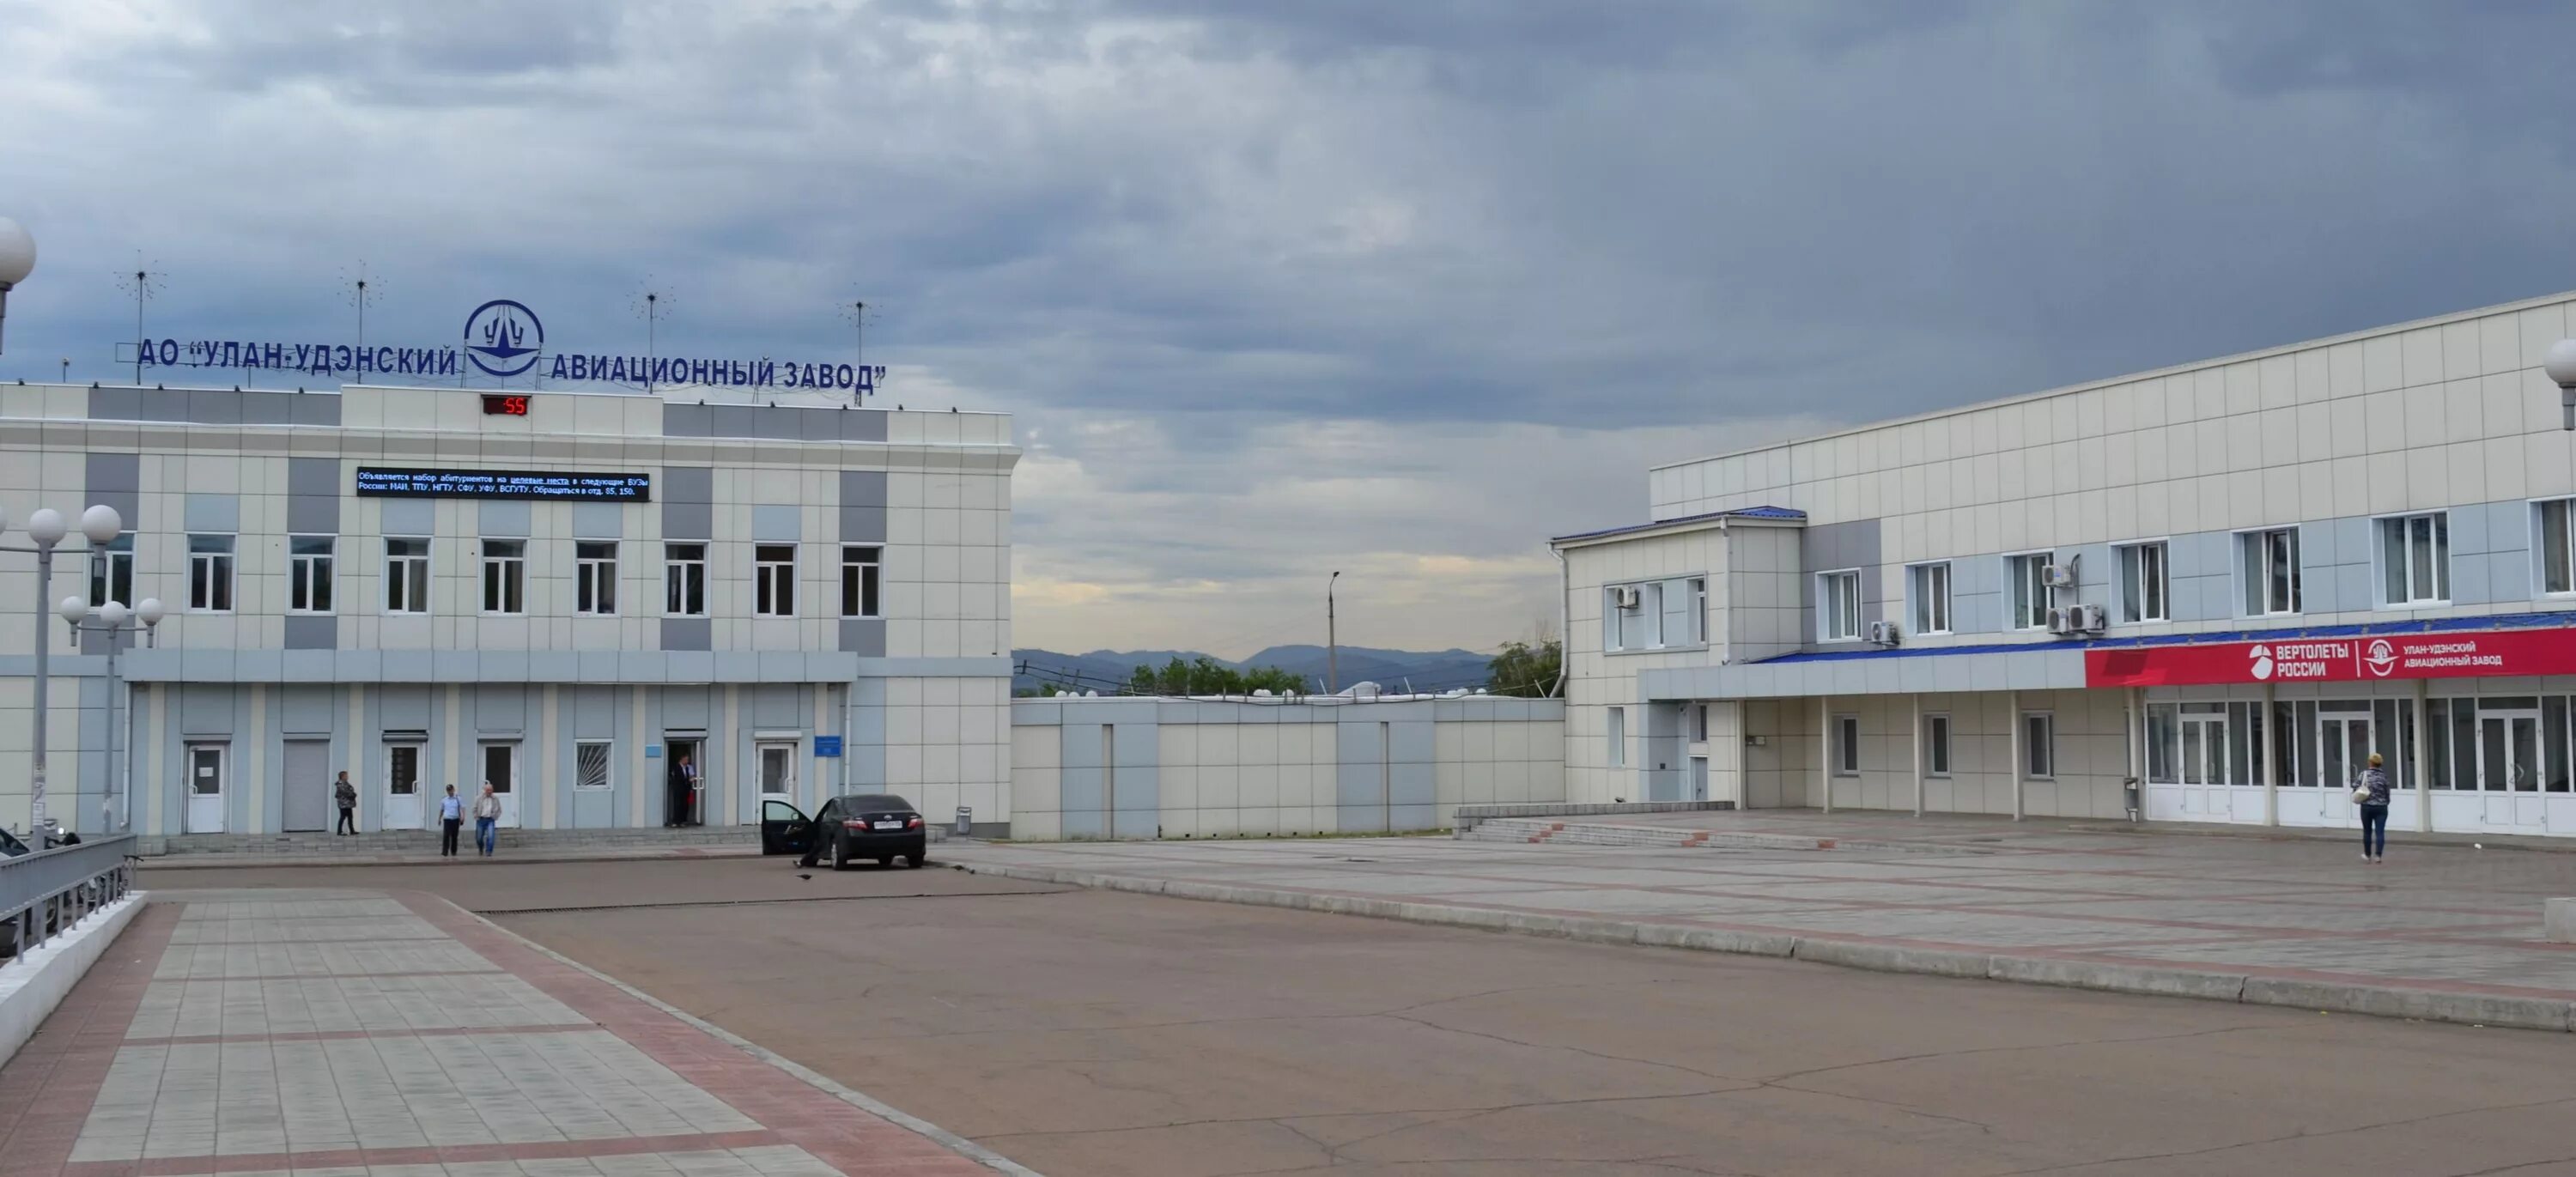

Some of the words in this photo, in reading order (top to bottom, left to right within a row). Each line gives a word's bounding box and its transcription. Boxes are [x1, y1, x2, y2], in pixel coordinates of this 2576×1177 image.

[137, 338, 179, 367] АО
[550, 354, 774, 387] АВИАЦИОННЫЙ
[358, 472, 410, 481] Объявляется
[413, 474, 436, 482] набор
[440, 474, 494, 483] абитуриентов
[533, 486, 580, 494] Обращаться
[2276, 643, 2349, 660] ВЕРТОЛЕТЫ
[2403, 640, 2476, 654] УЛАН-УДЭНСКИЙ
[2404, 654, 2471, 668] АВИАЦИОННЫЙ
[2472, 655, 2502, 666] ЗАВОД
[2277, 662, 2326, 677] РОССИИ
